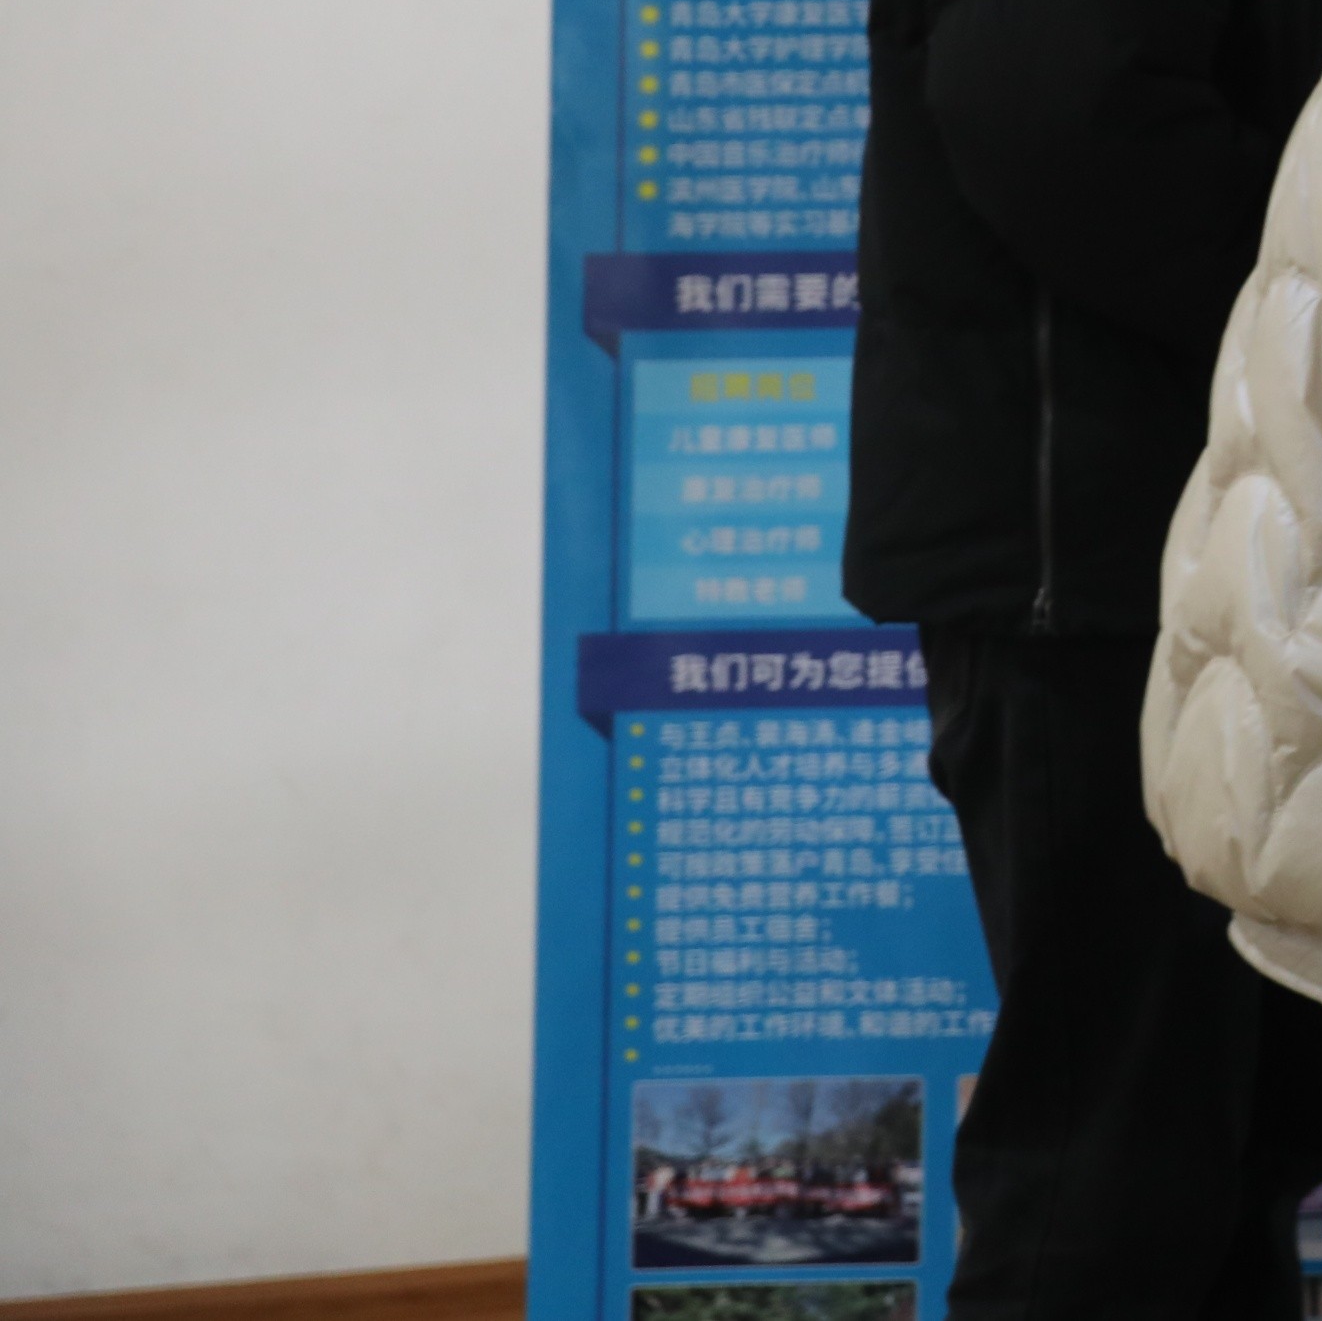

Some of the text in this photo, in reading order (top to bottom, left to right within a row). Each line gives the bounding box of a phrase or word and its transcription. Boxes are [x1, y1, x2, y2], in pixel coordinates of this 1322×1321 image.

[676, 272, 861, 314] 我们需要的
